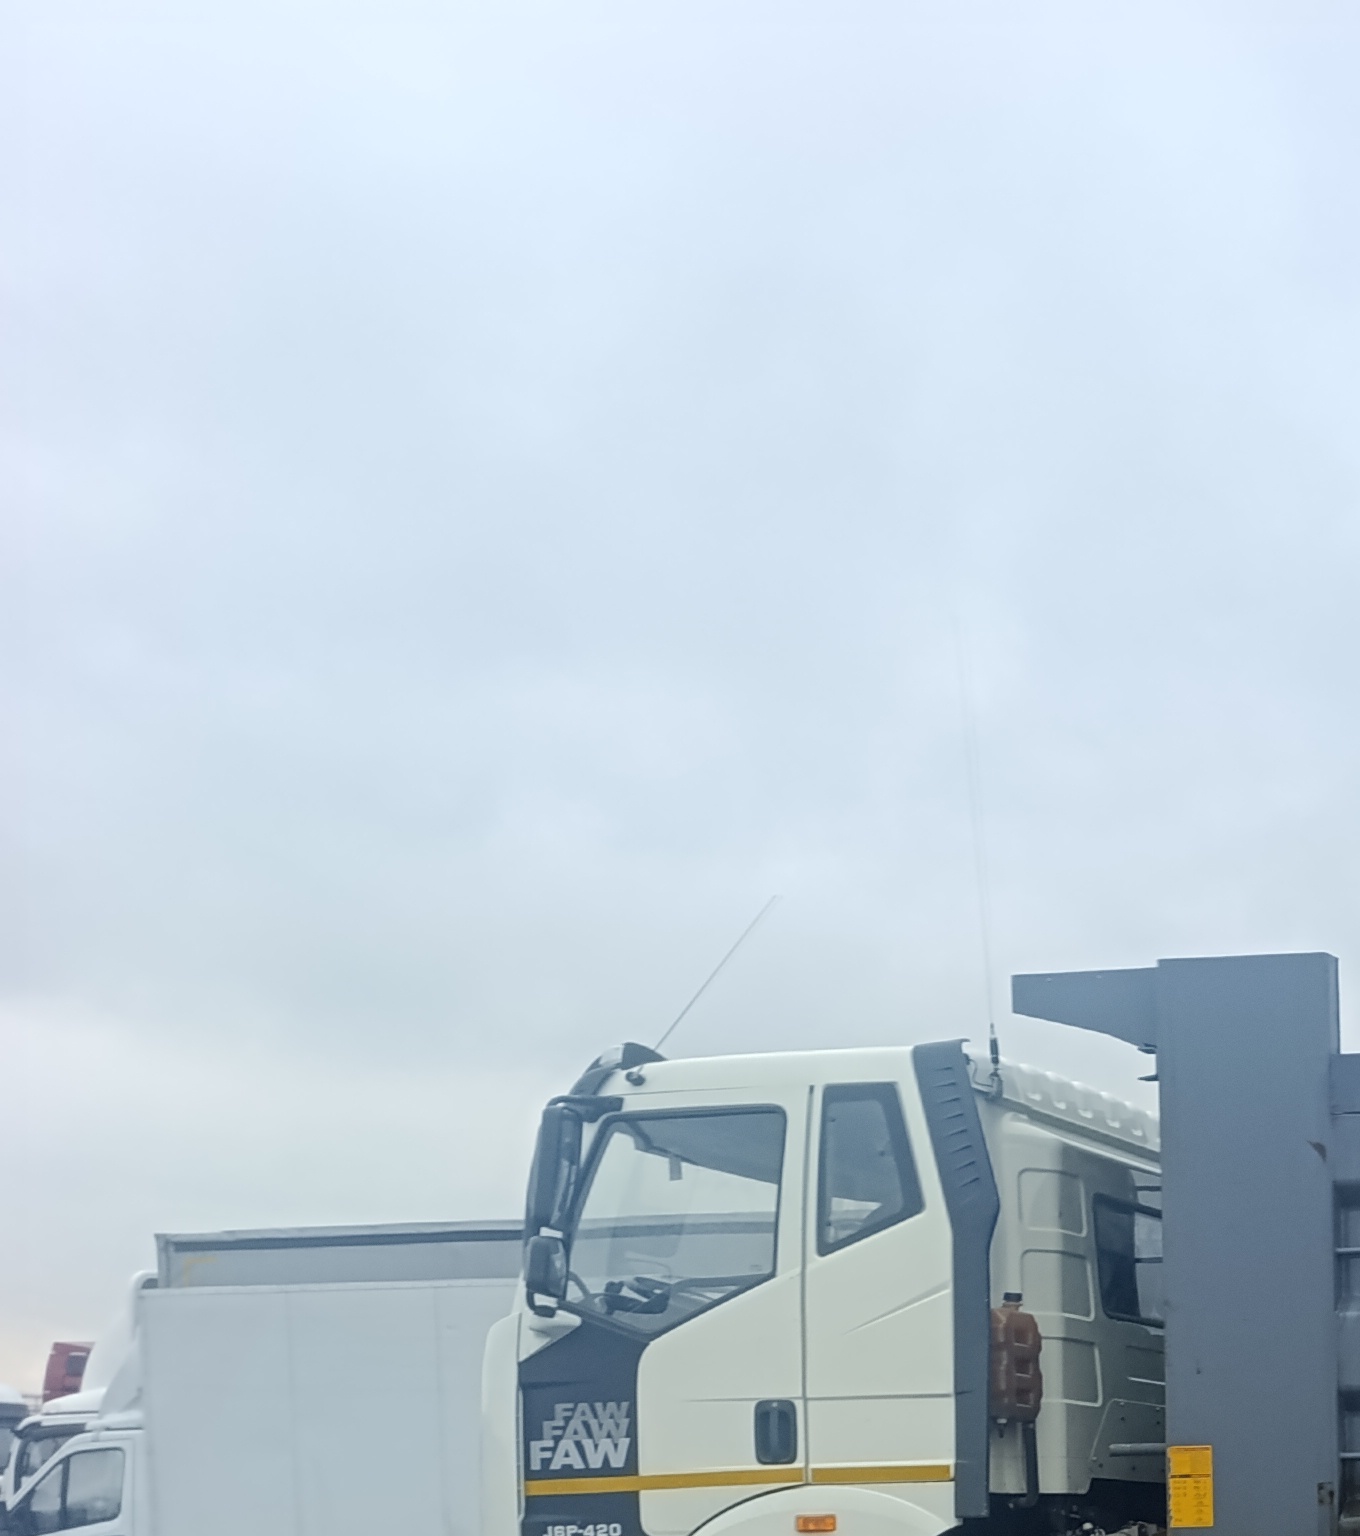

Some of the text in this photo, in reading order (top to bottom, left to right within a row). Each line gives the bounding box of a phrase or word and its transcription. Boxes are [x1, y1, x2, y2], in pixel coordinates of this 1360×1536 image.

[554, 1401, 630, 1422] FAW
[542, 1418, 630, 1442] FAW
[529, 1437, 631, 1470] FAW
